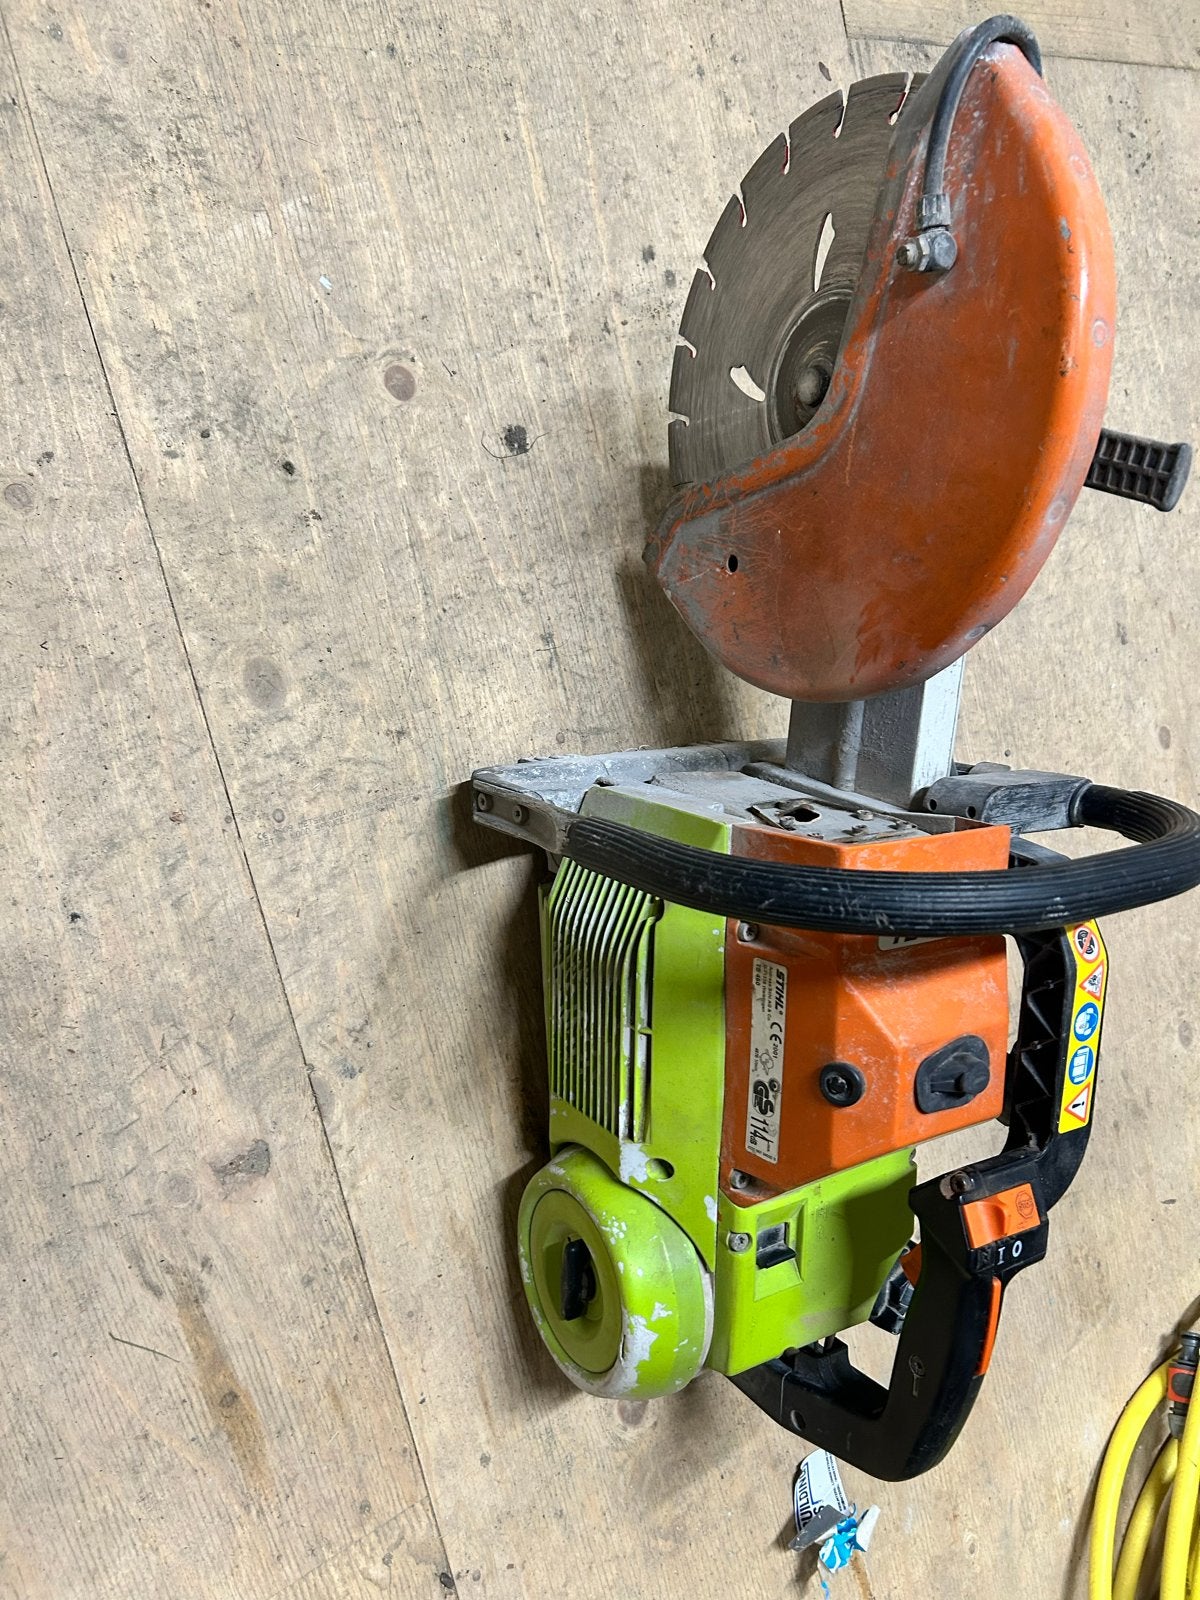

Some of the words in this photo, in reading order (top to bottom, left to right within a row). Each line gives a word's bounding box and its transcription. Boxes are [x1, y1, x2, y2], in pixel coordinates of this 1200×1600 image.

[775, 969, 785, 1010] STIHL
[770, 1022, 783, 1045] CE
[753, 1080, 774, 1115] GS
[750, 1116, 774, 1143] 114
